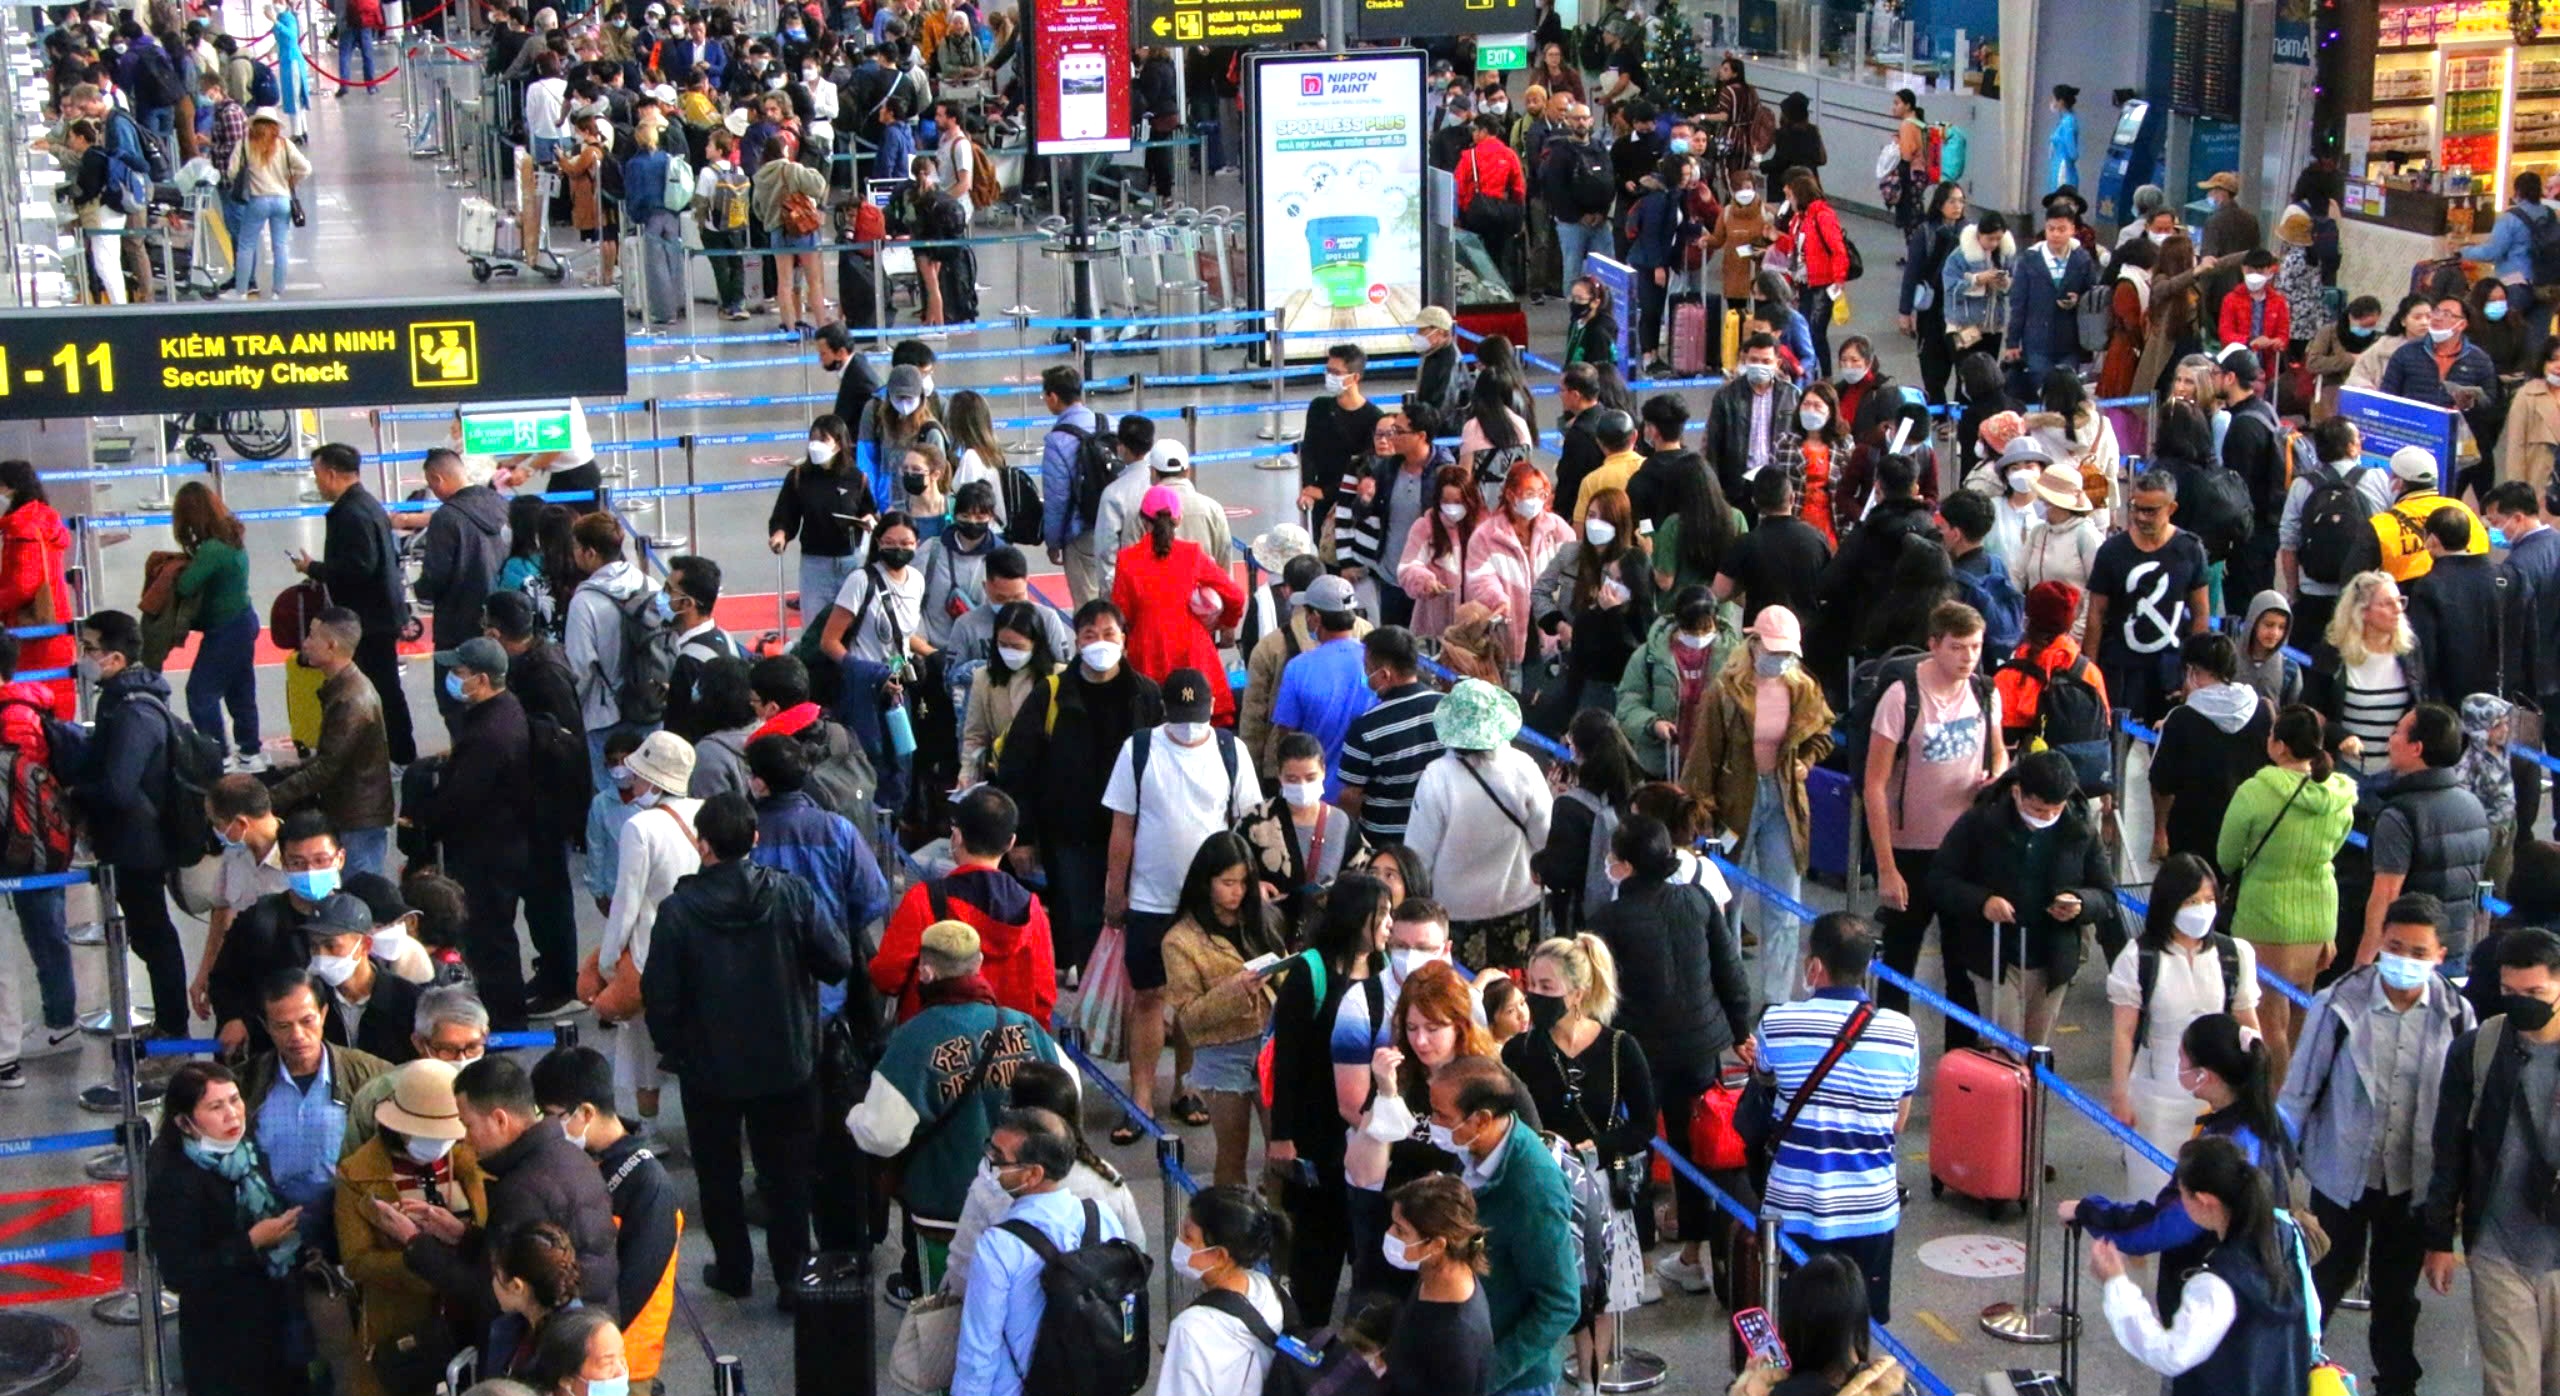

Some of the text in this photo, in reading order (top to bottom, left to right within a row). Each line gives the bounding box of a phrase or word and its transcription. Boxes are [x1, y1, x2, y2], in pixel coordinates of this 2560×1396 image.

[1237, 11, 1257, 21] TRA
[1259, 10, 1274, 20] AN
[1277, 9, 1302, 19] NINH
[1208, 22, 1283, 36] Security Check
[1487, 50, 1509, 66] EXIT
[1327, 71, 1377, 84] NIPPON
[1331, 83, 1369, 94] PAINT
[231, 333, 286, 356] TRA
[290, 332, 327, 354] AN
[334, 329, 396, 352] NINH
[53, 342, 114, 394] 11
[163, 361, 349, 390] Security Check
[930, 1034, 972, 1073] GET
